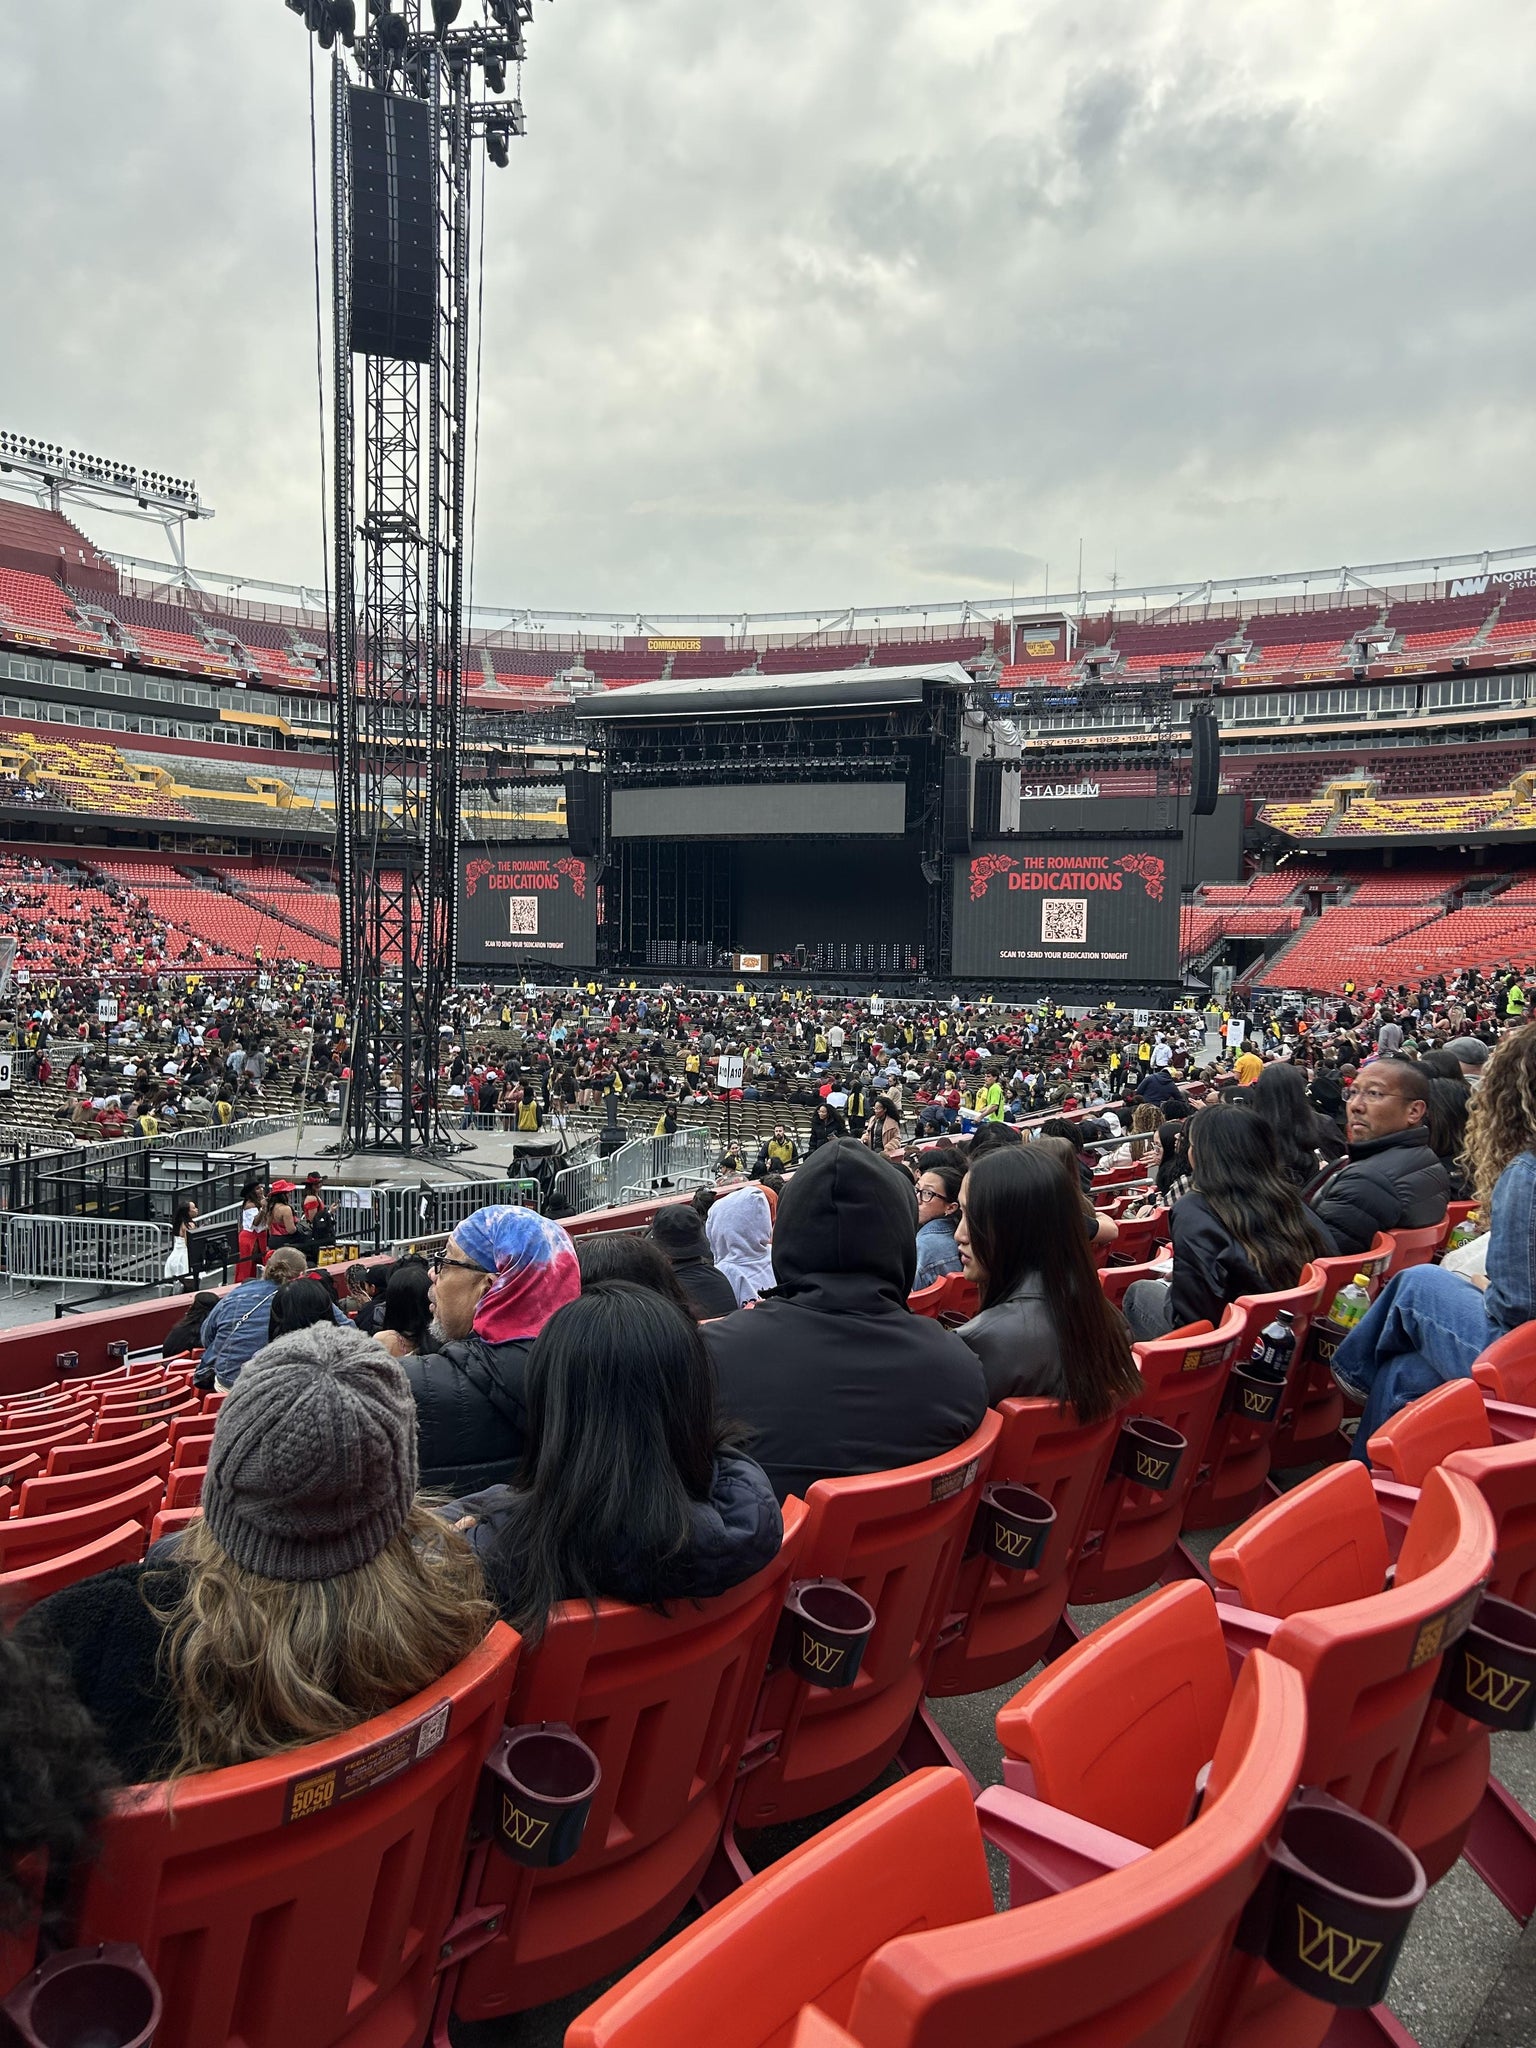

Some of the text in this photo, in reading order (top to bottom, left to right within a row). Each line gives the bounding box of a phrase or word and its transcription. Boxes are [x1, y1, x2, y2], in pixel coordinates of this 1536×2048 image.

[648, 640, 701, 650] COMMANDERS
[1025, 784, 1100, 797] STADIUM
[498, 860, 550, 871] THE ROMANTIC
[1024, 856, 1109, 869] THE ROMANTIC
[489, 874, 559, 890] DEDICATIONS
[1008, 872, 1123, 891] DEDICATIONS
[1000, 950, 1016, 958] SCAN
[730, 1068, 741, 1078] A10
[1136, 1451, 1169, 1480] W
[994, 1522, 1031, 1558] W
[803, 1632, 844, 1673] W
[1465, 1652, 1531, 1712] W
[290, 1800, 333, 1820] RAFFLE
[503, 1796, 549, 1849] W
[1298, 1904, 1382, 1984] W
